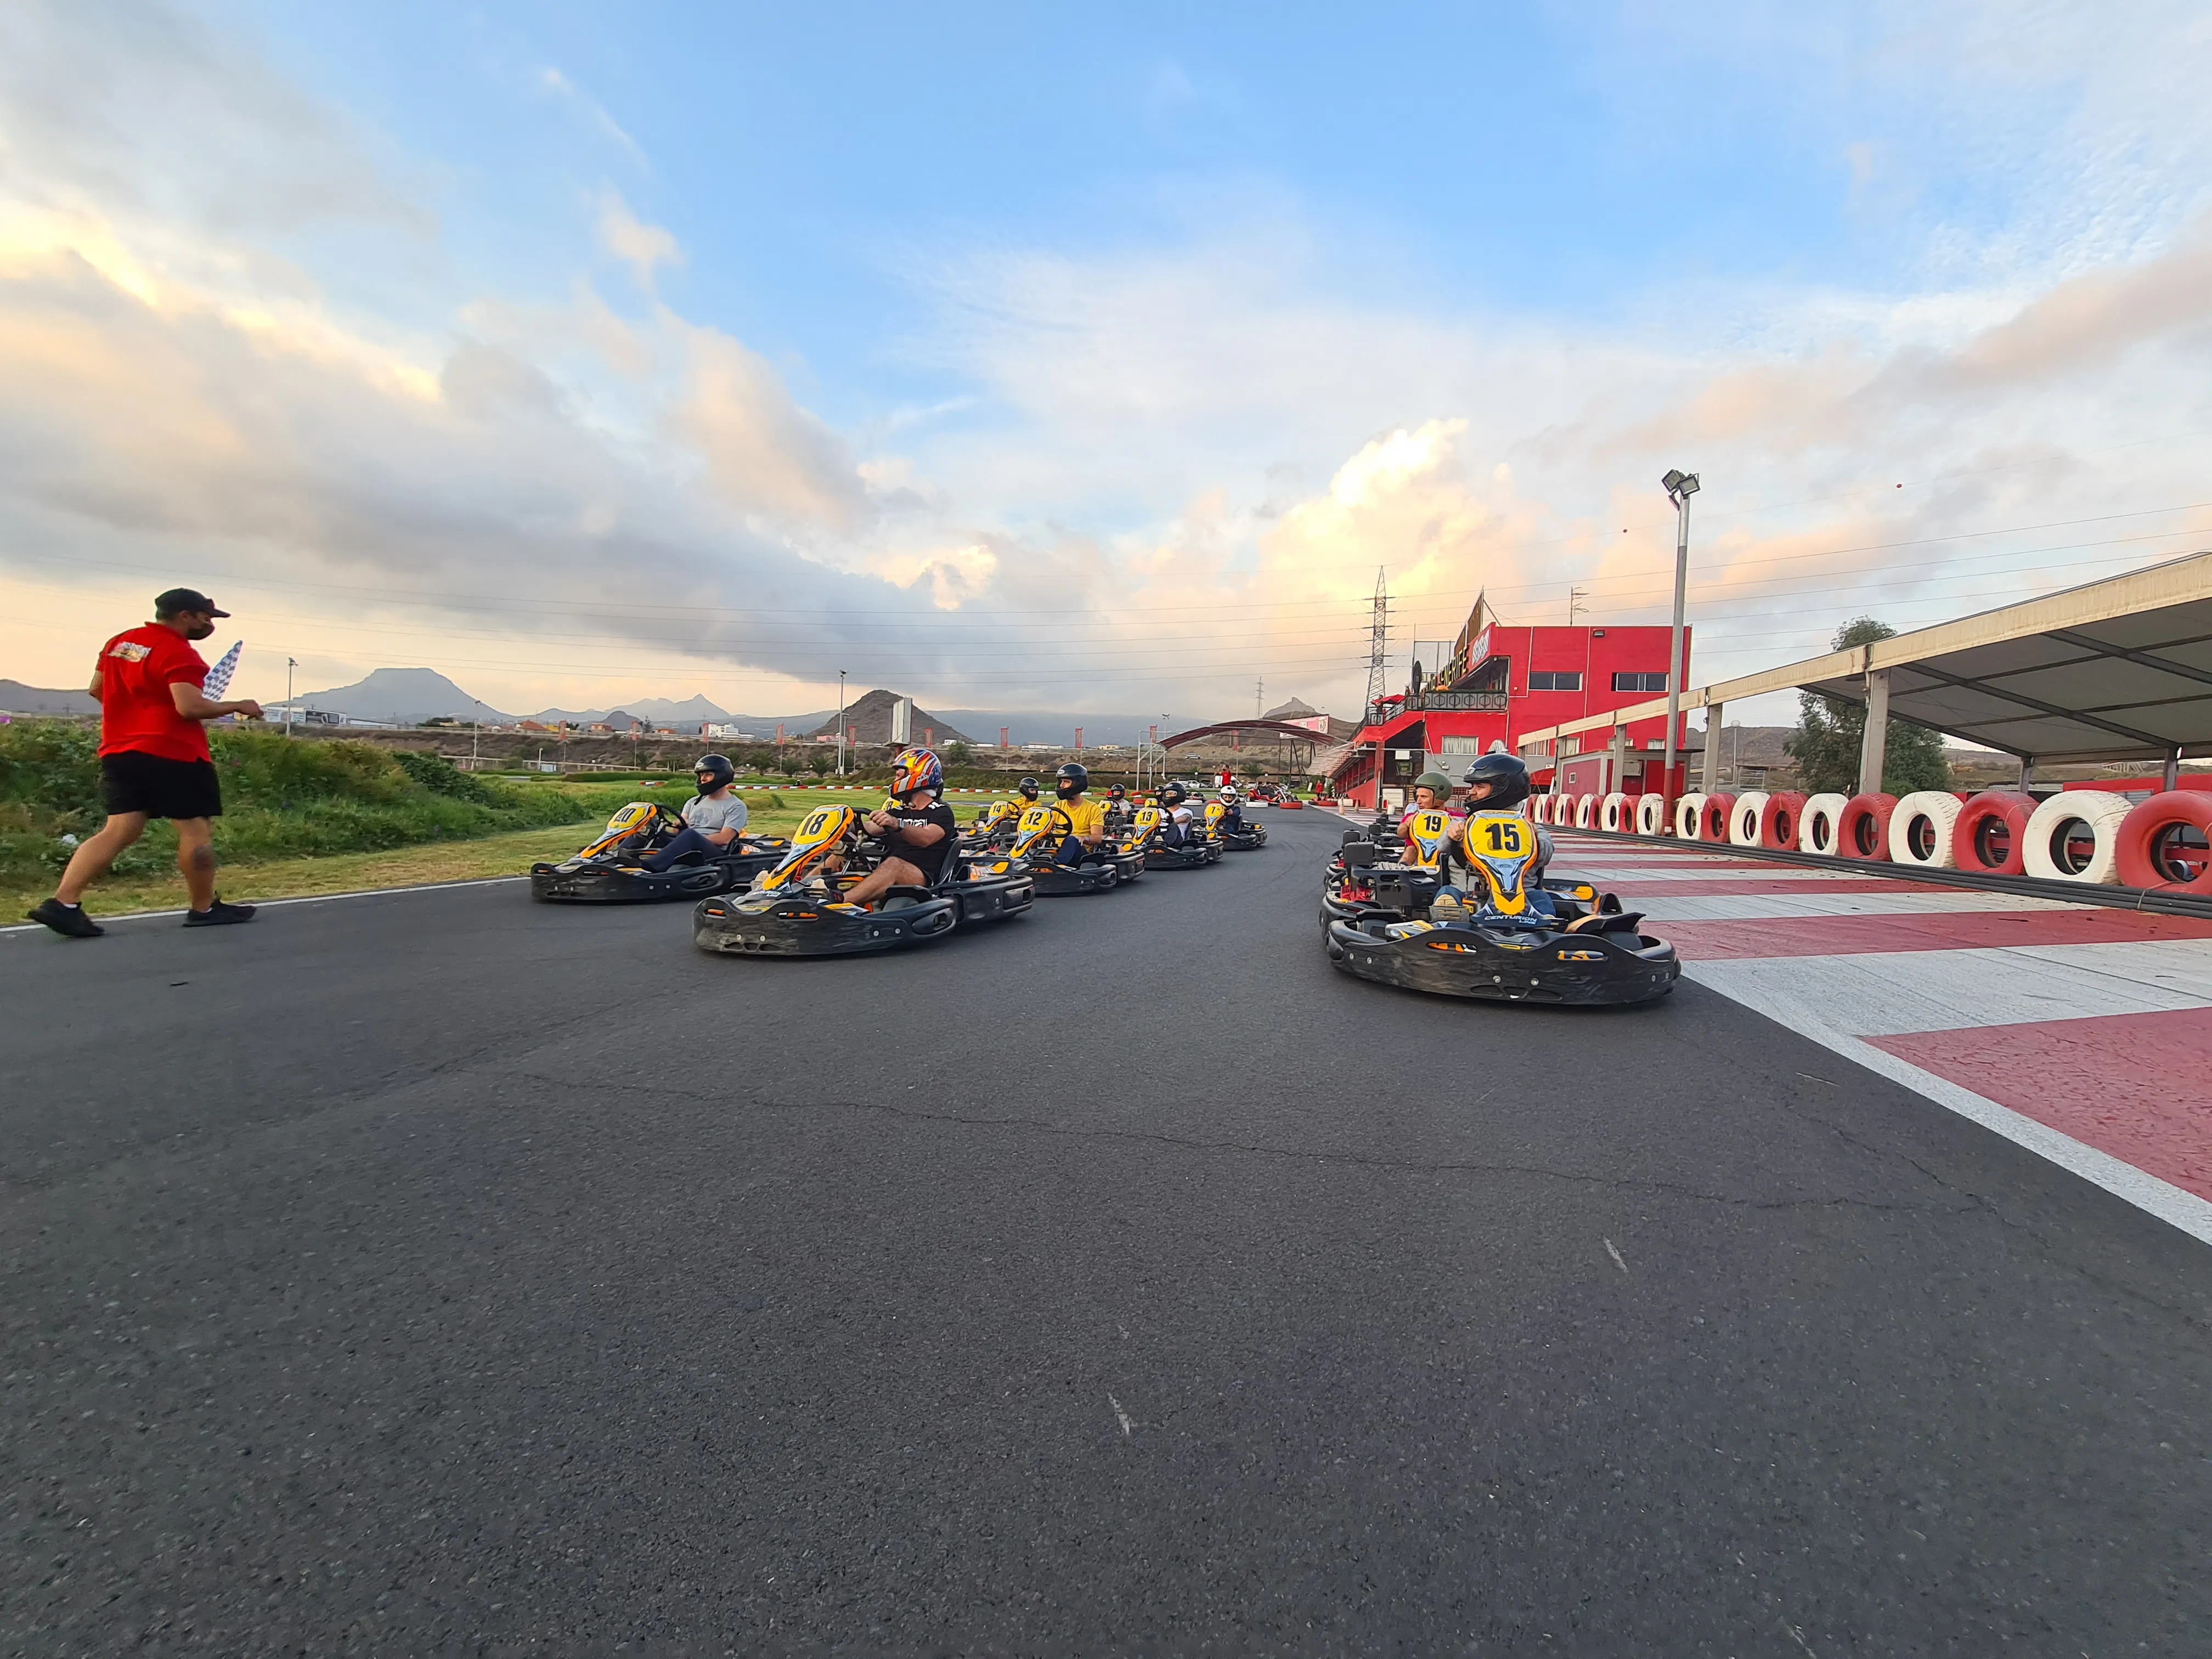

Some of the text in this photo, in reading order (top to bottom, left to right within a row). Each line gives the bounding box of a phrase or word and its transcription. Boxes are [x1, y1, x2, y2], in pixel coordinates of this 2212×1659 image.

[614, 808, 636, 823] 20
[993, 805, 1002, 814] 14
[1142, 811, 1153, 821] 13
[800, 813, 829, 836] 18
[1028, 811, 1043, 826] 12
[1423, 815, 1442, 832] 19
[1485, 823, 1520, 851] 15
